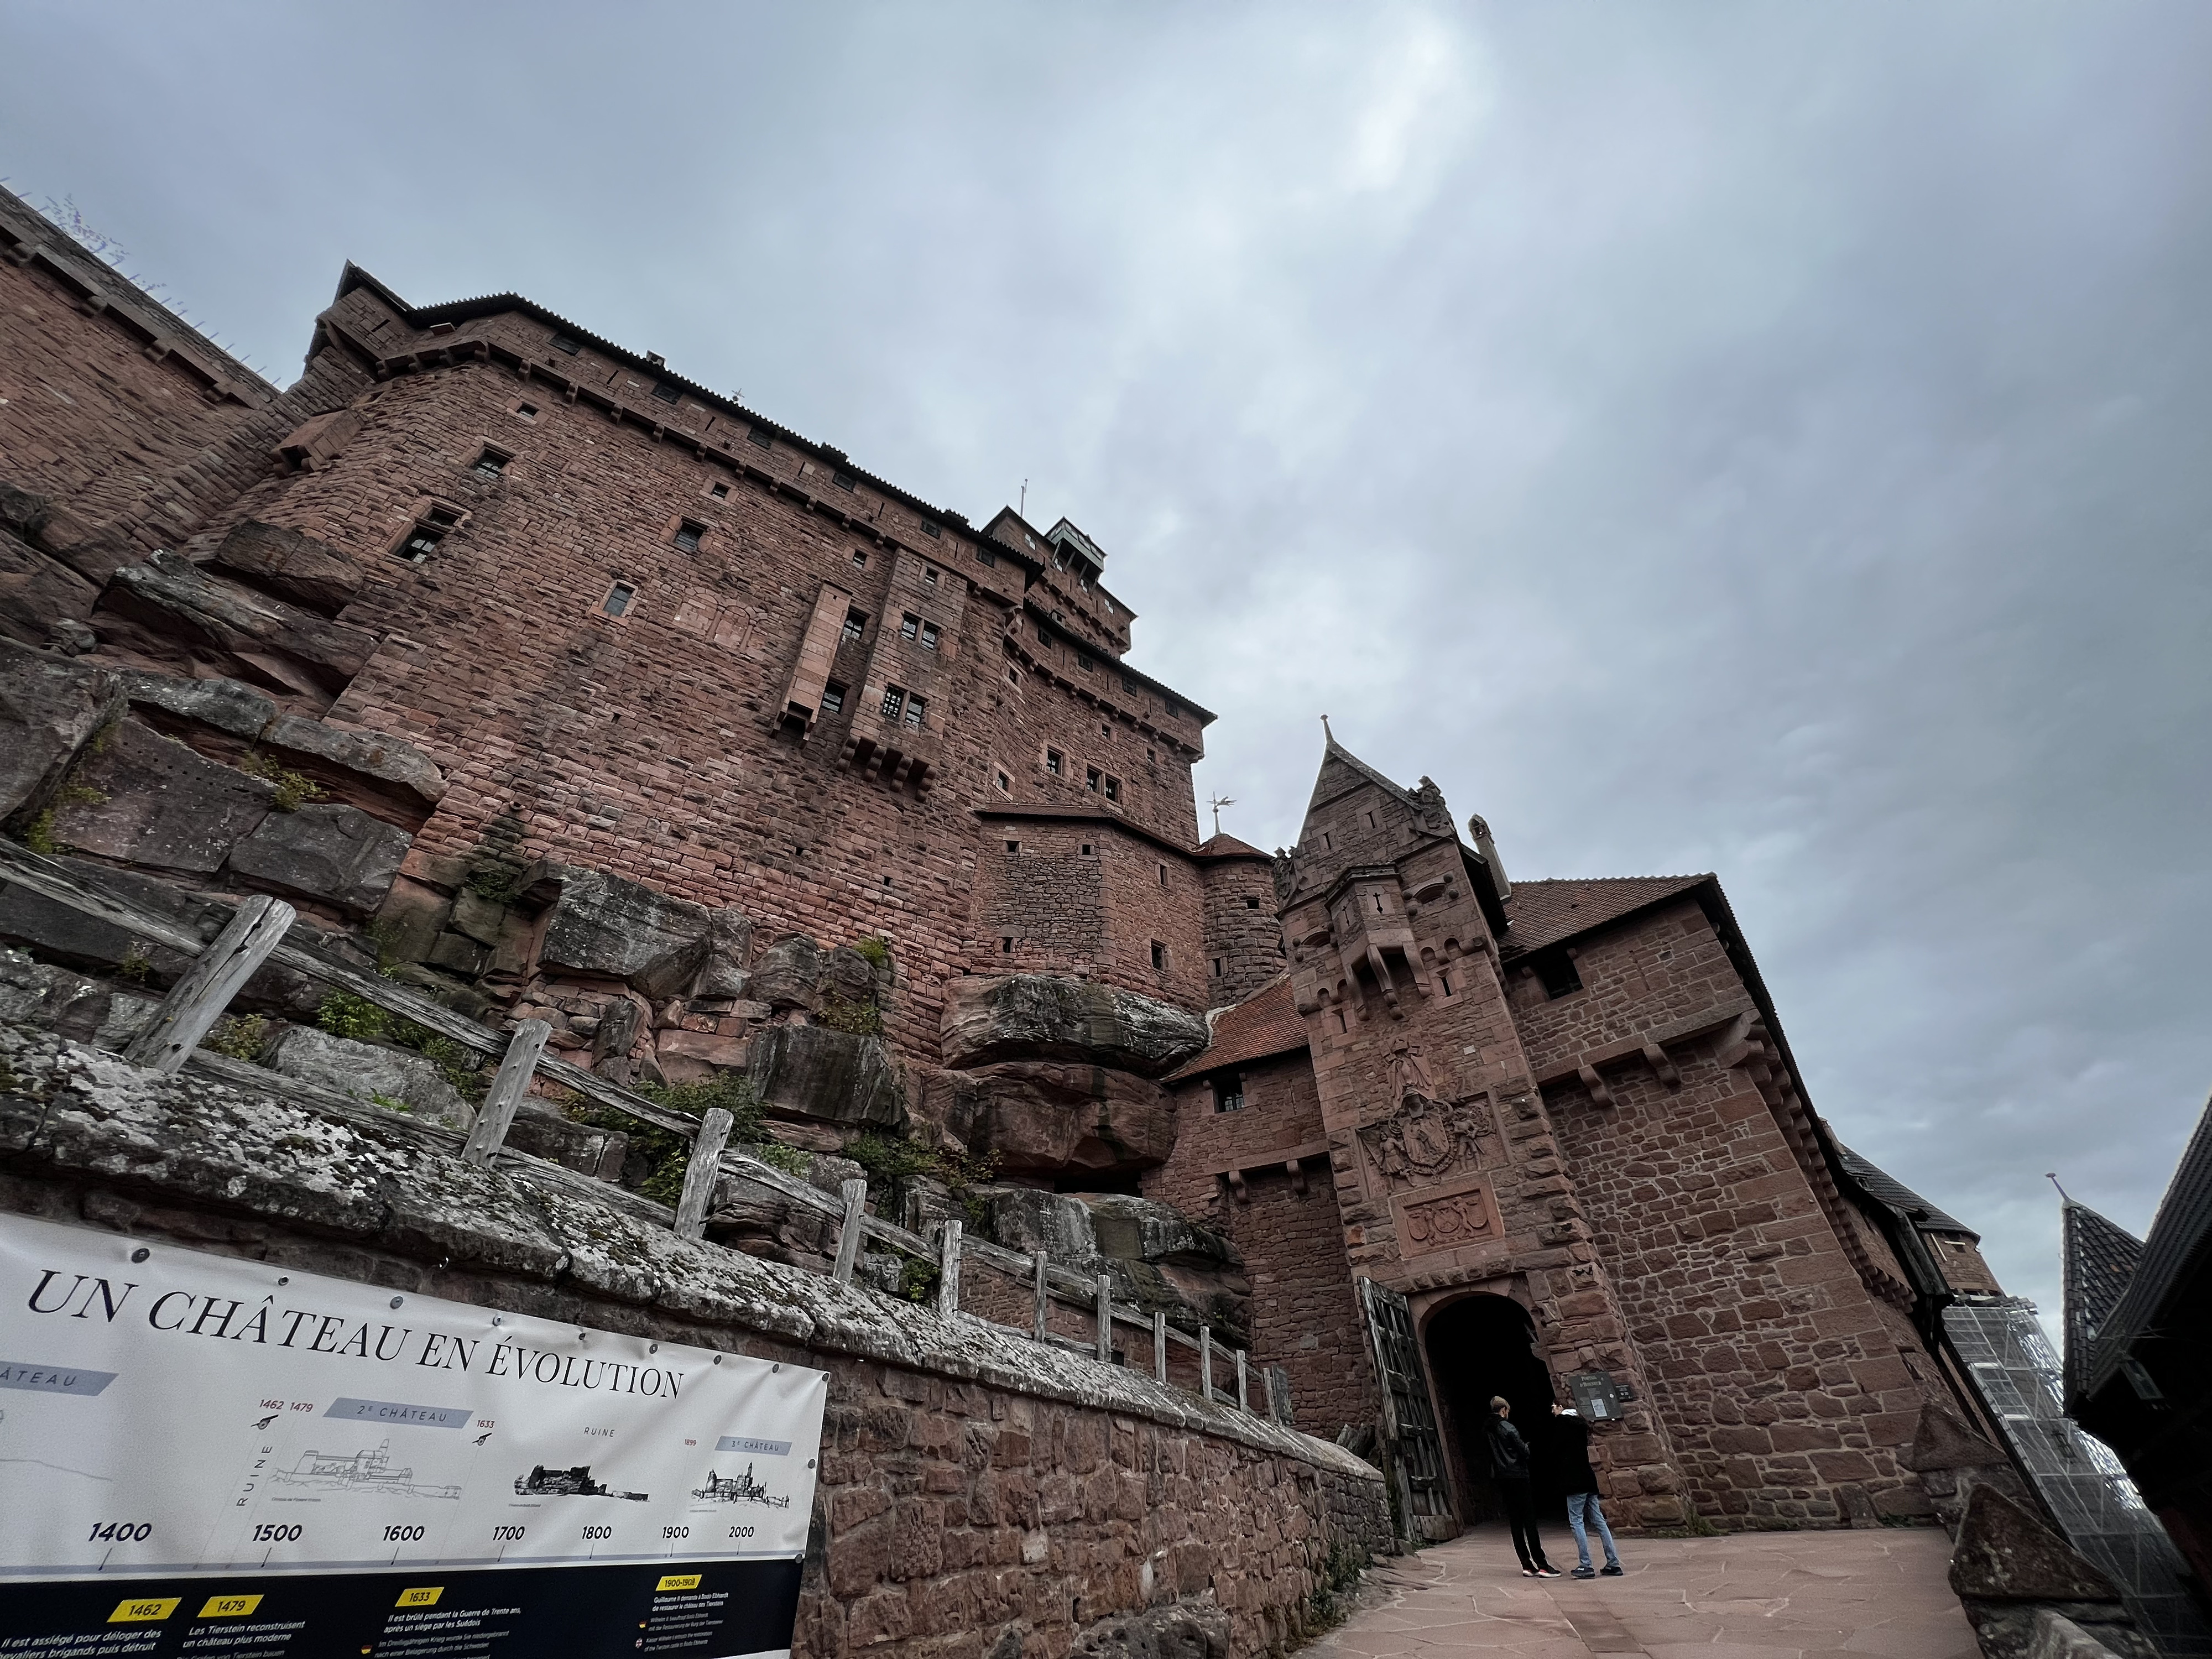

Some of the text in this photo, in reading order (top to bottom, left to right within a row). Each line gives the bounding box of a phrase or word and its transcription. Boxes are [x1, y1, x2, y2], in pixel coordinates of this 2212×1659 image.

[28, 1269, 684, 1399] UN CHÂTEAU EN ÉVOLUTION
[259, 1399, 313, 1412] 1462 1479
[379, 1407, 447, 1422] CHÂTEAU
[477, 1420, 495, 1428] 1633
[583, 1427, 615, 1437] RUINE
[744, 1441, 779, 1452] CHÂTEAU
[236, 1446, 273, 1506] RUINE
[88, 1522, 754, 1542] 1400 1500 1600 1700 1800 1900 2000
[665, 1578, 695, 1588] 1900-1908
[409, 1592, 430, 1602] 1633
[128, 1604, 161, 1616] 1462
[217, 1600, 246, 1612] 1479
[424, 1611, 451, 1621] pendant
[189, 1627, 205, 1636] Les
[384, 1623, 403, 1633] après
[432, 1622, 444, 1631] par
[456, 1619, 481, 1627] Suédois
[11, 1637, 30, 1647] est
[32, 1634, 73, 1646] assiégé
[74, 1634, 101, 1645] pour
[102, 1631, 143, 1641] déloger
[144, 1629, 161, 1638] des
[196, 1637, 233, 1647] château
[232, 1635, 253, 1646] plus
[254, 1634, 292, 1643] moderne
[48, 1646, 96, 1658] brigands
[97, 1644, 119, 1656] puis
